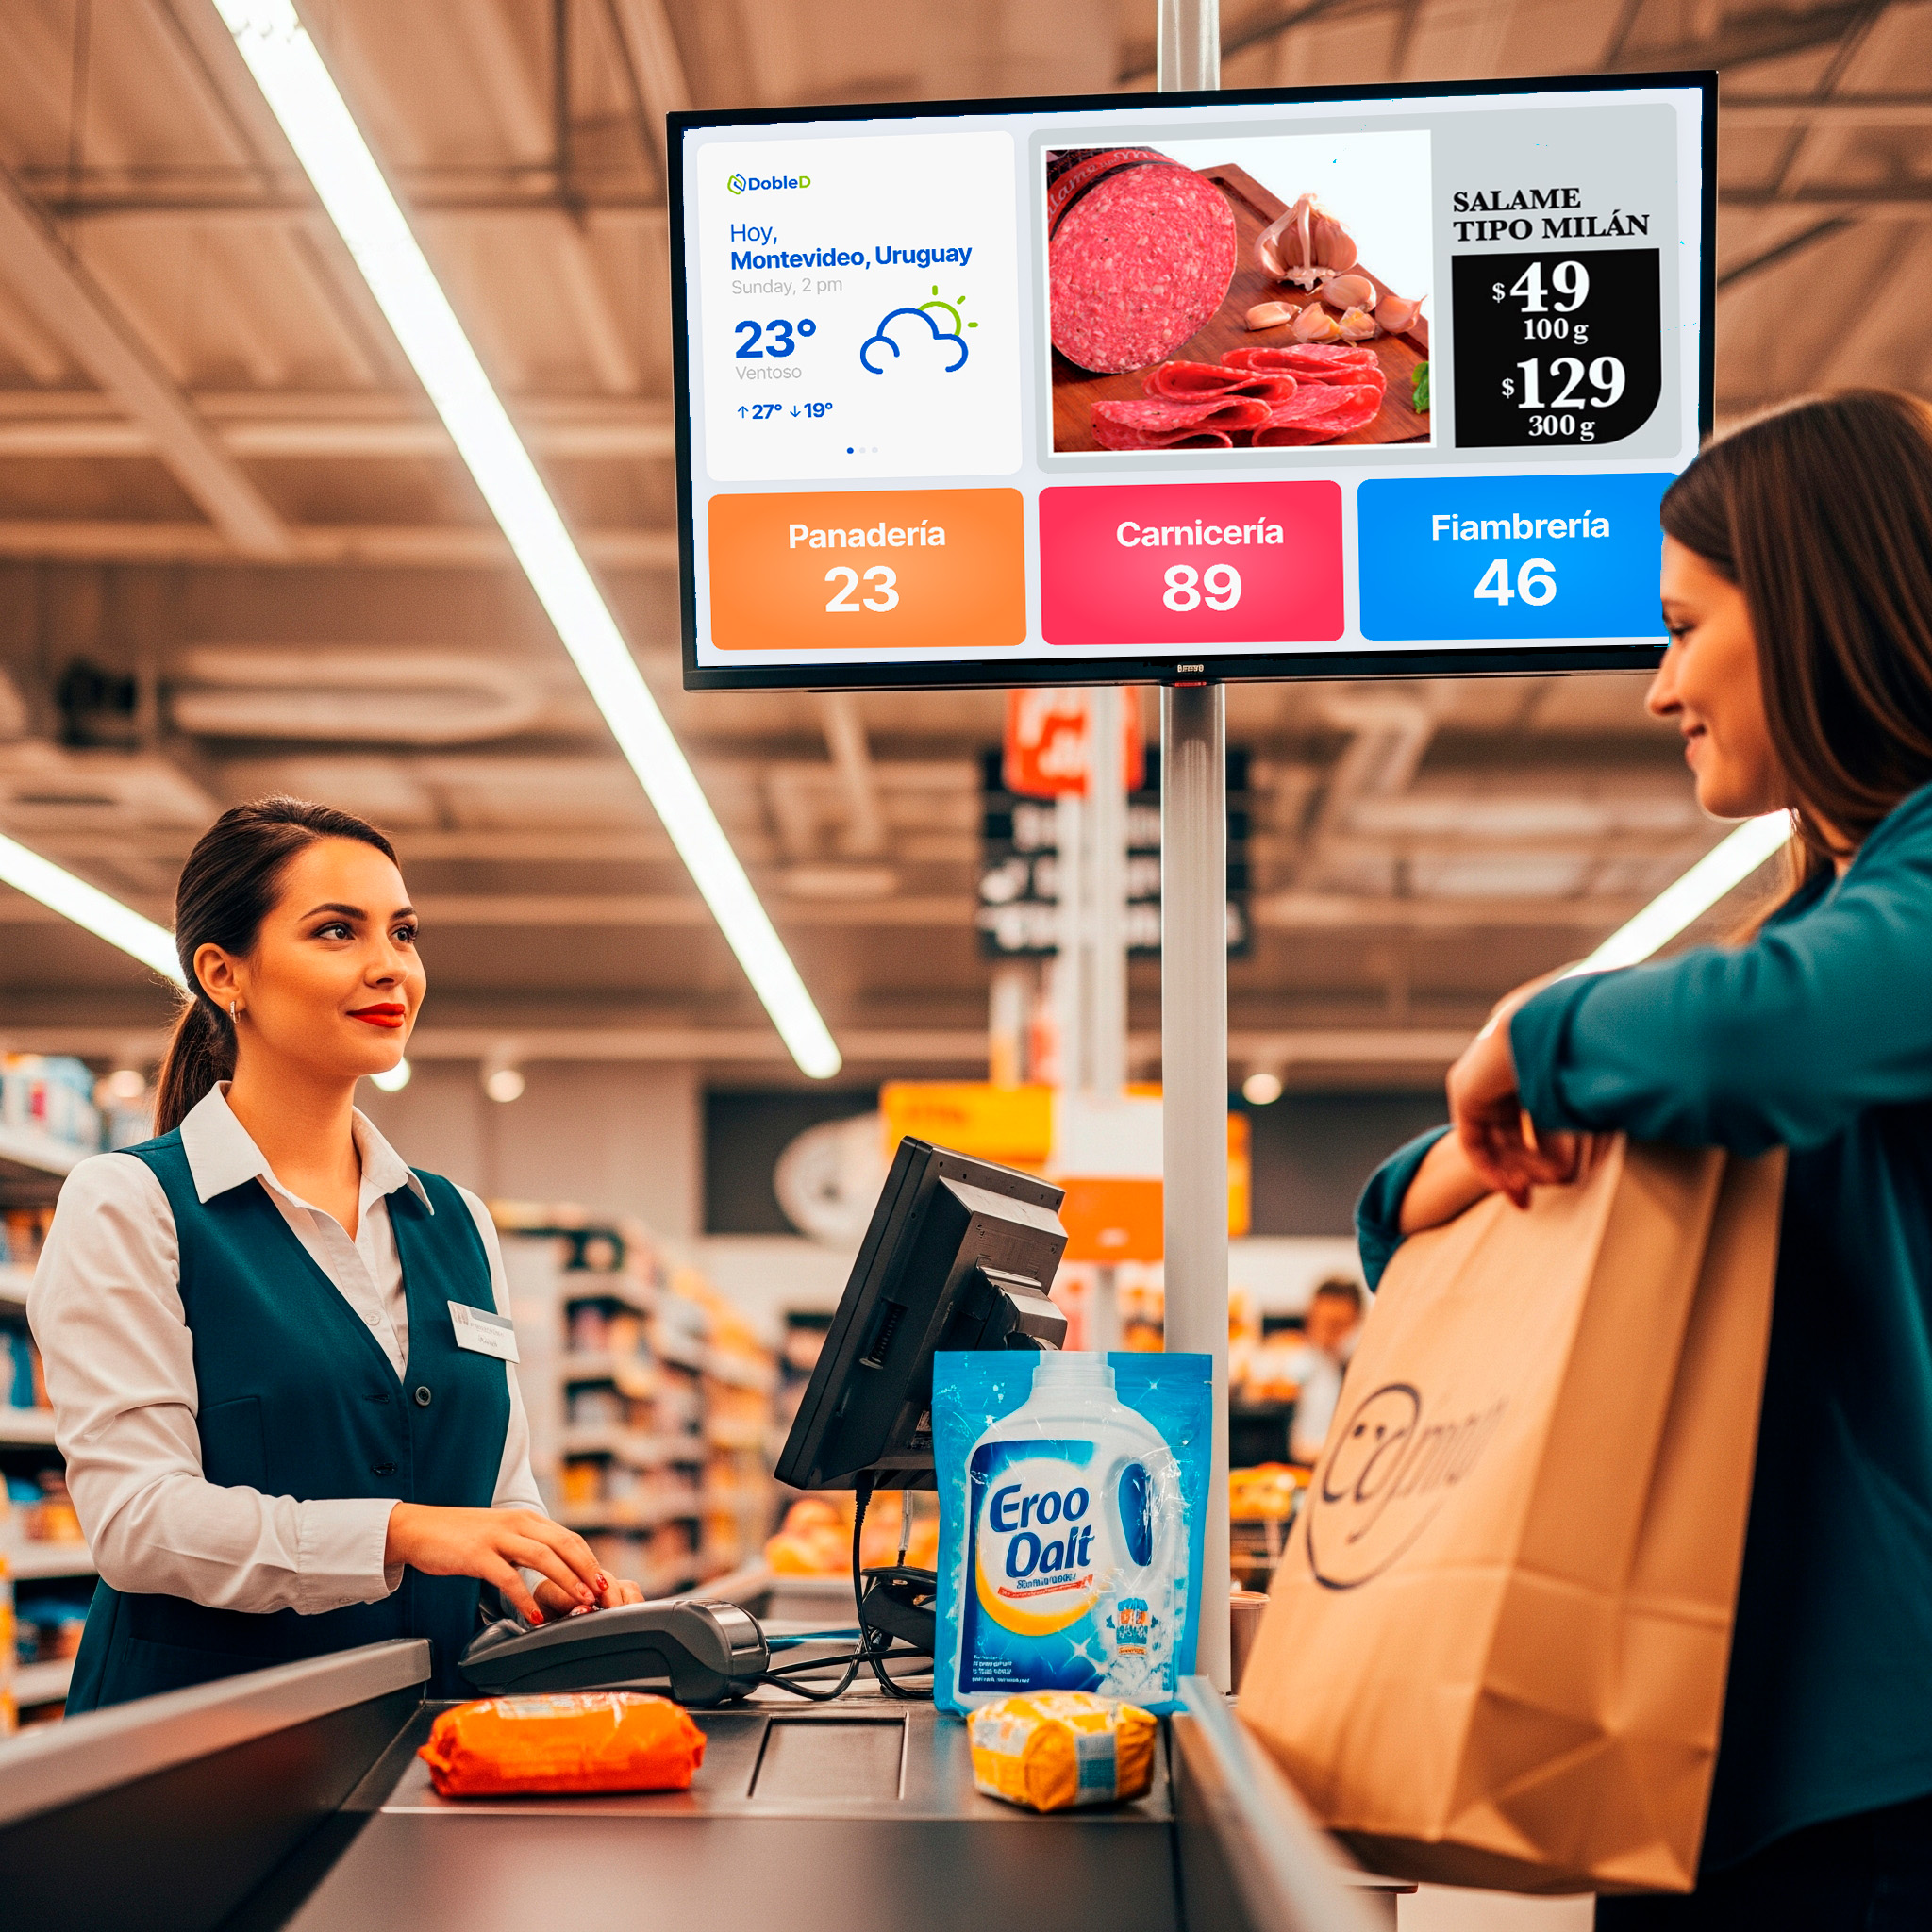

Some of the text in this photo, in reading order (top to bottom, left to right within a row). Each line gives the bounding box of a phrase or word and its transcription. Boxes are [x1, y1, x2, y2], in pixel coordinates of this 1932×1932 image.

[748, 175, 812, 192] DobleD
[1453, 188, 1582, 213] SALAME
[730, 223, 778, 246] Hoy,
[1453, 208, 1651, 242] TIPO MILÁN
[730, 245, 974, 271] Montevideo, Uruguay
[731, 277, 843, 297] Sunday, 2 pm
[734, 317, 817, 359] 23°
[1524, 317, 1590, 346] 100 g
[735, 364, 803, 381] Ventoso
[751, 401, 834, 421] 27° 19°
[1527, 413, 1596, 442] 300 g
[789, 519, 946, 549] Panadería
[1116, 516, 1284, 547] Carnicería
[1432, 509, 1609, 541] Fiambrería
[824, 565, 900, 613] 23
[1162, 563, 1241, 612] 89
[1474, 558, 1557, 607] 46
[989, 1483, 1090, 1533] Eroo
